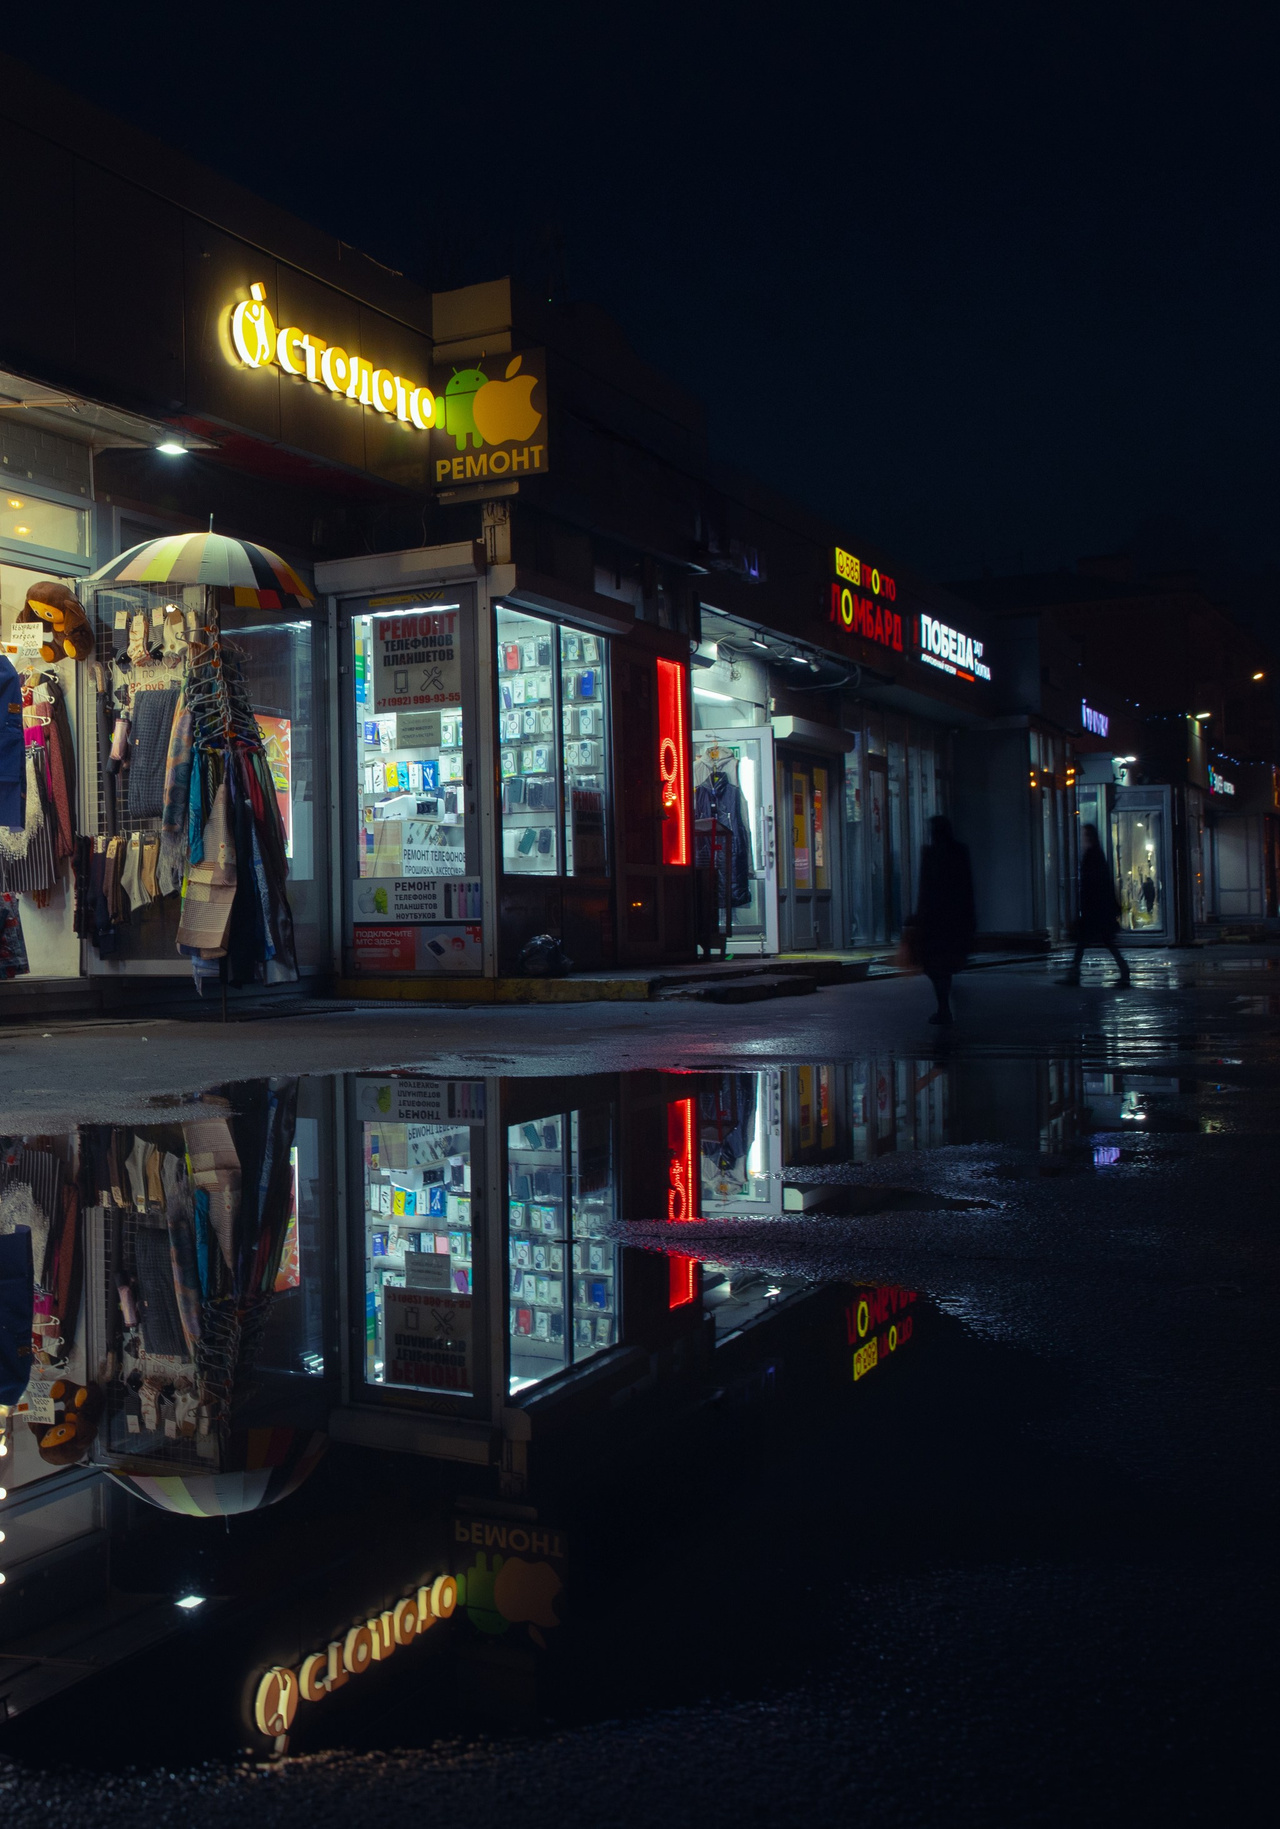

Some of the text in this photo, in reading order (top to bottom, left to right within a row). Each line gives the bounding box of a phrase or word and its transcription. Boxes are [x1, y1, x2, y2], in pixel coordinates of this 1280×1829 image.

[276, 326, 436, 430] СТОЛОТО
[436, 445, 543, 482] РЕМОНТ
[861, 562, 896, 602] ПРОСТО
[379, 611, 457, 641] РЕМОНТ
[830, 583, 903, 652] ЛОМБАРД
[383, 634, 454, 652] ТЕЛЕФОНОВ
[921, 613, 974, 671] ПОБЕДА
[383, 648, 455, 667] ПЛАНШЕТОВ
[376, 699, 387, 707] +7
[403, 849, 429, 861] РЕМОНТ
[394, 881, 437, 891] РЕМОНТ
[395, 893, 437, 901] ТЕЛЕФОНОВ
[396, 912, 437, 920] НОУТБУКОВ
[355, 930, 413, 938] ПОДКЛЮЧИТЕ
[374, 938, 401, 946] ЗДЕСЬ
